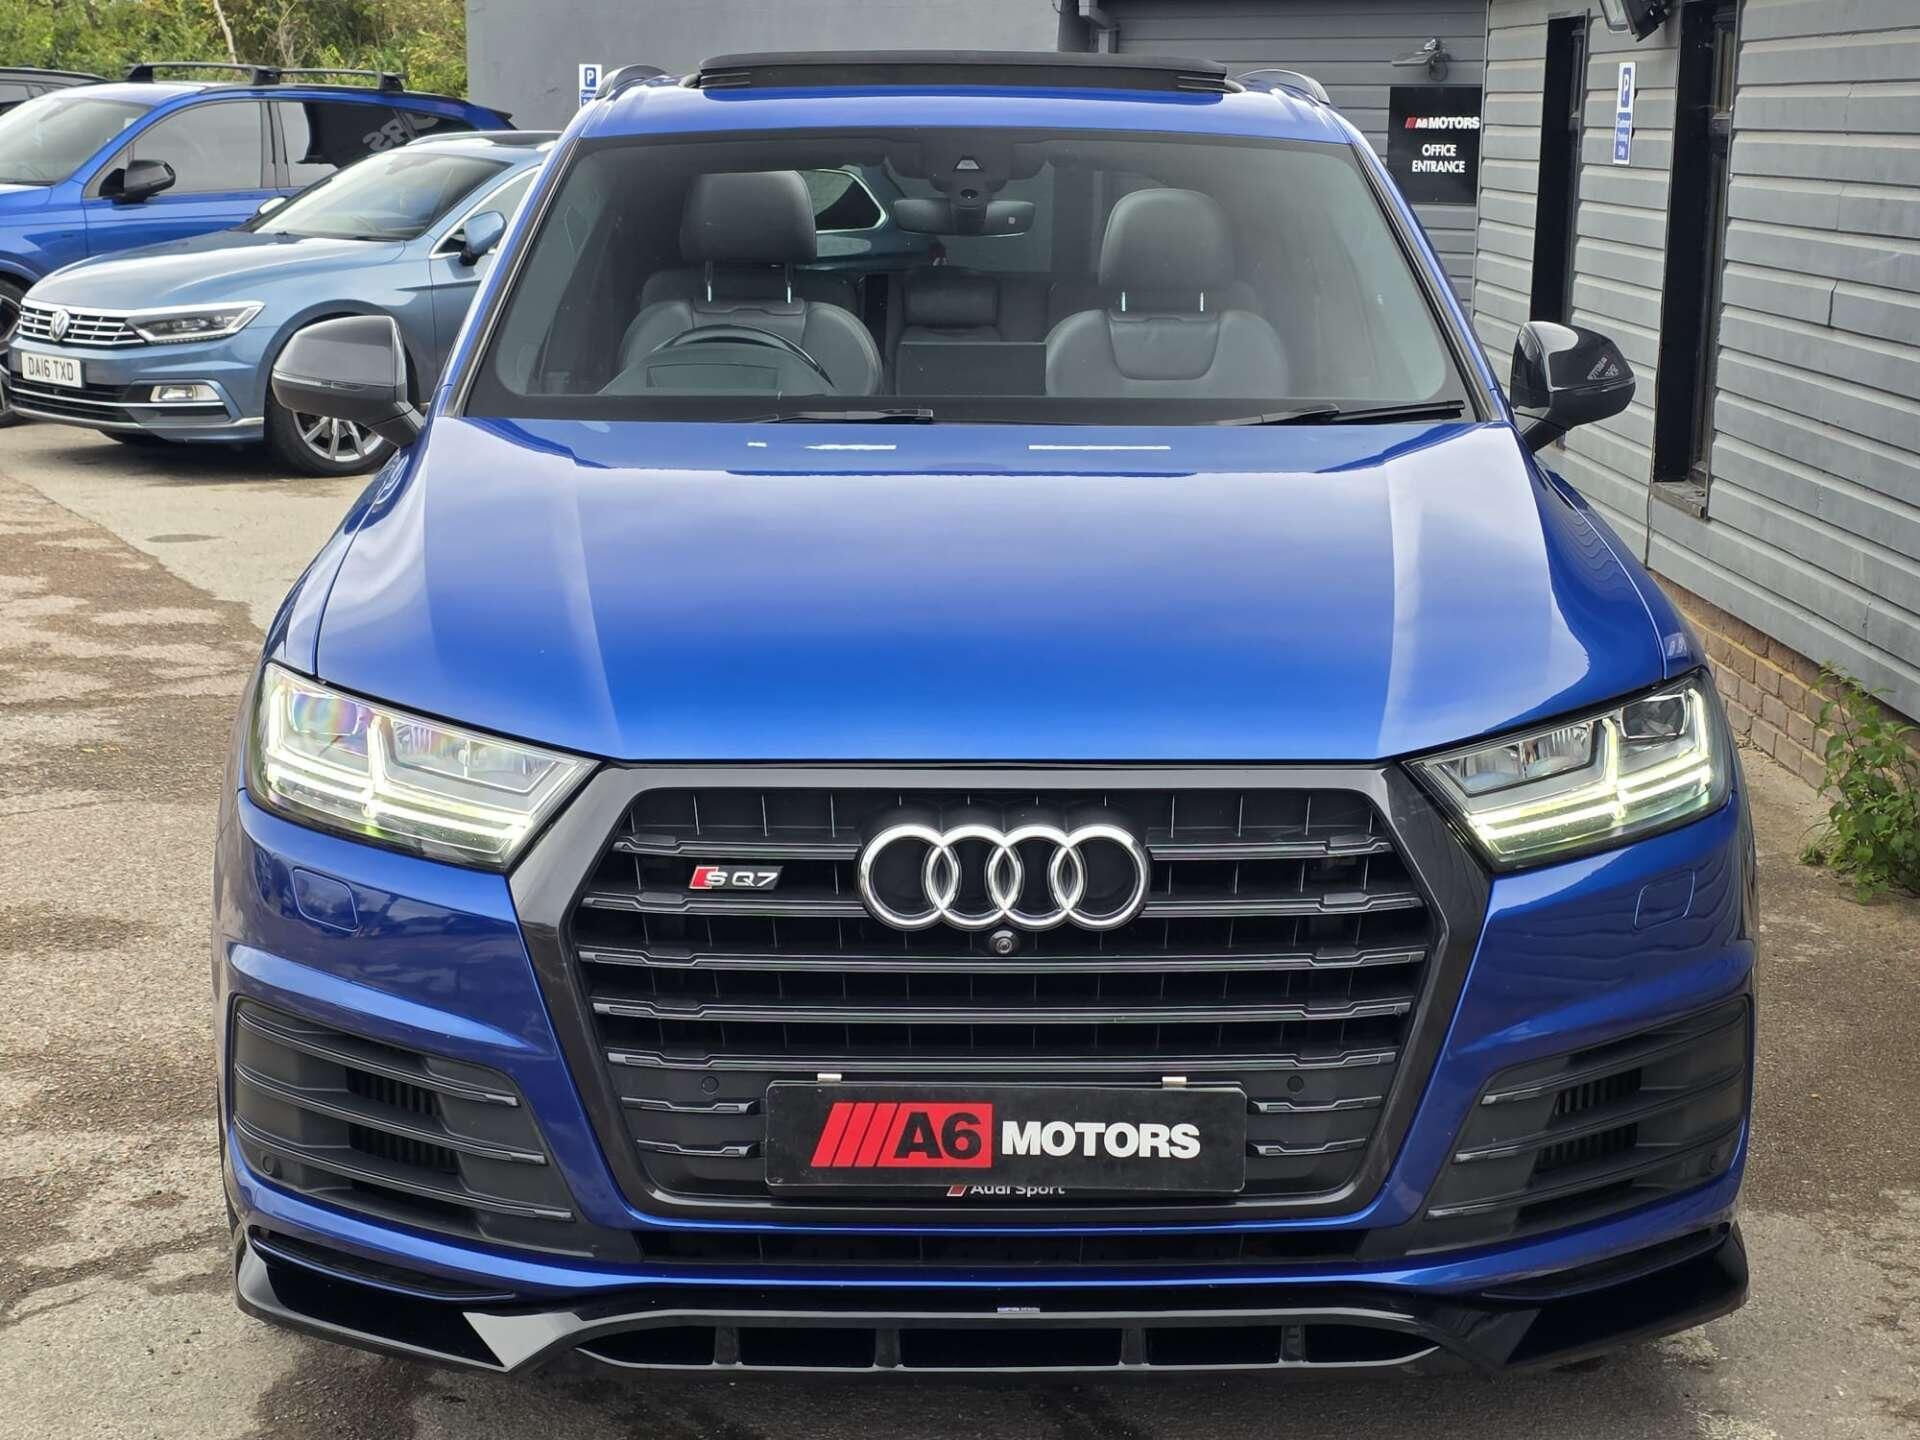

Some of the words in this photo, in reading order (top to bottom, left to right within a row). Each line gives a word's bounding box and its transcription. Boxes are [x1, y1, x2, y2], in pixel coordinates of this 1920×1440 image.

[587, 70, 595, 85] P
[1623, 73, 1631, 102] P
[1428, 116, 1480, 129] MOTORS
[1422, 143, 1457, 157] OFFICE
[1411, 160, 1465, 173] ENTRANCE
[28, 356, 51, 378] DA16
[53, 360, 74, 381] TXD
[894, 1111, 982, 1159] A6
[1001, 1120, 1201, 1160] MOTORS
